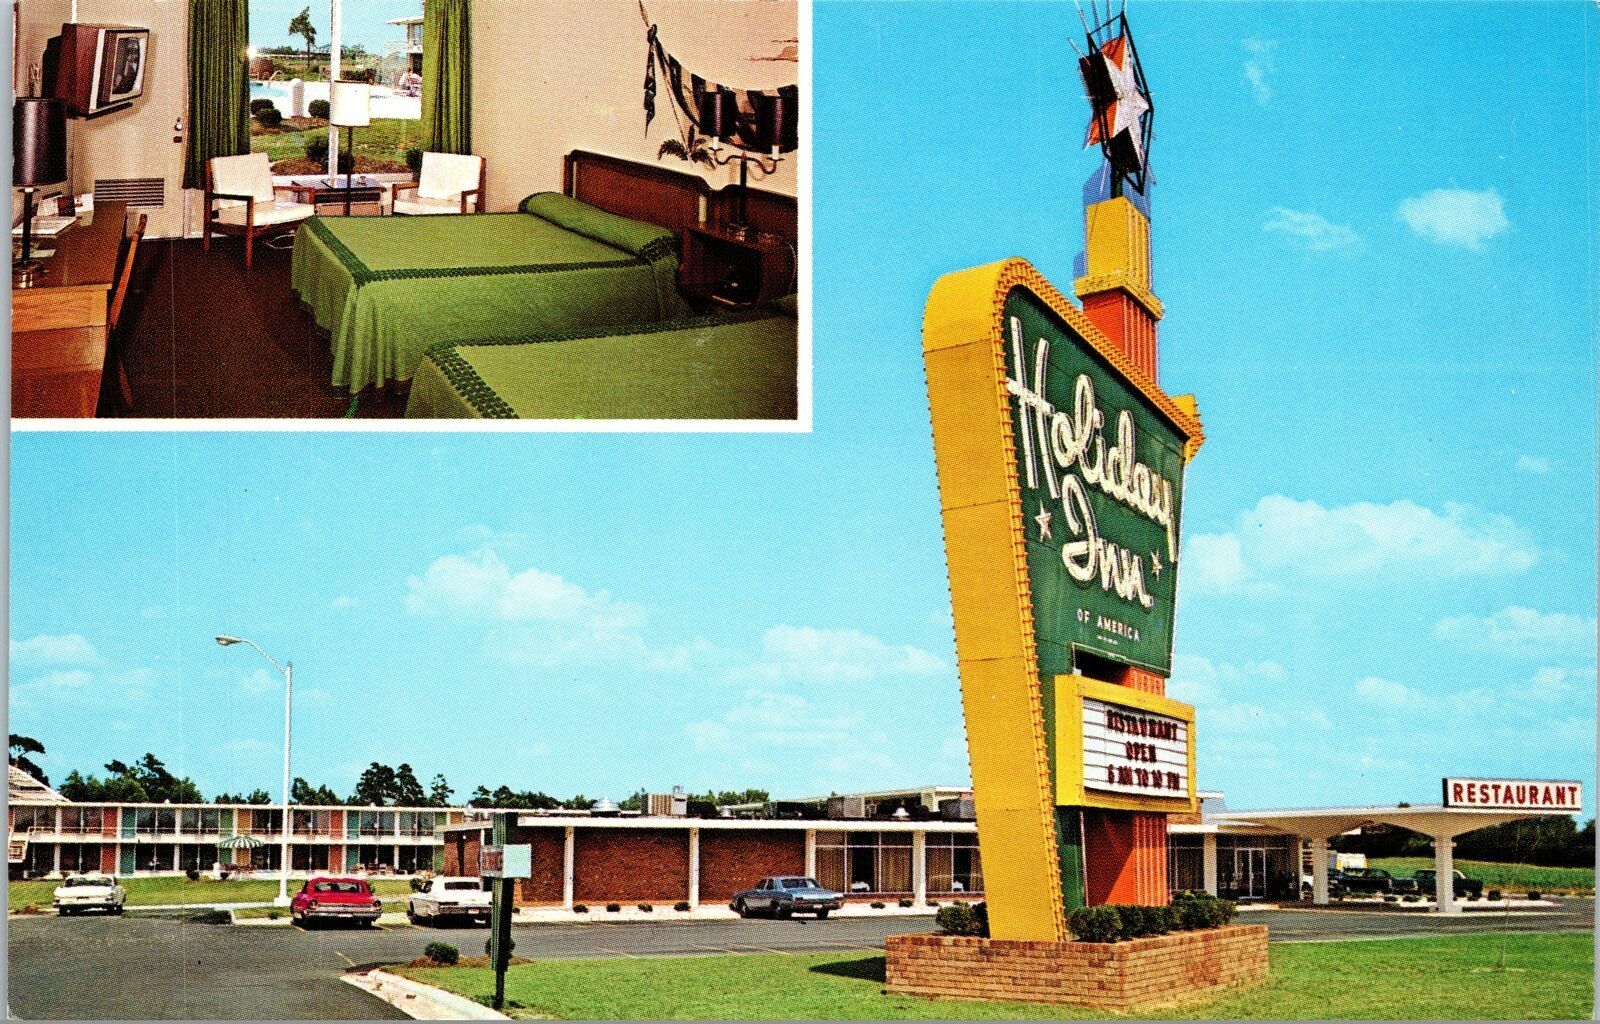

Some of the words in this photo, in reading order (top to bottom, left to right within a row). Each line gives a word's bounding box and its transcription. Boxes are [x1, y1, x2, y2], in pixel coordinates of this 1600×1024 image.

[1006, 316, 1178, 563] Holiday
[1062, 473, 1155, 608] Inn
[1077, 608, 1090, 623] OF
[1097, 615, 1140, 642] AMERICA
[1107, 709, 1178, 741] RESTAURANT
[1125, 741, 1157, 763] OPEN
[1107, 764, 1115, 785] 6
[1118, 765, 1133, 786] AM
[1135, 767, 1149, 788] TO
[1167, 771, 1180, 791] PM
[1453, 782, 1578, 806] RESTAURANT
